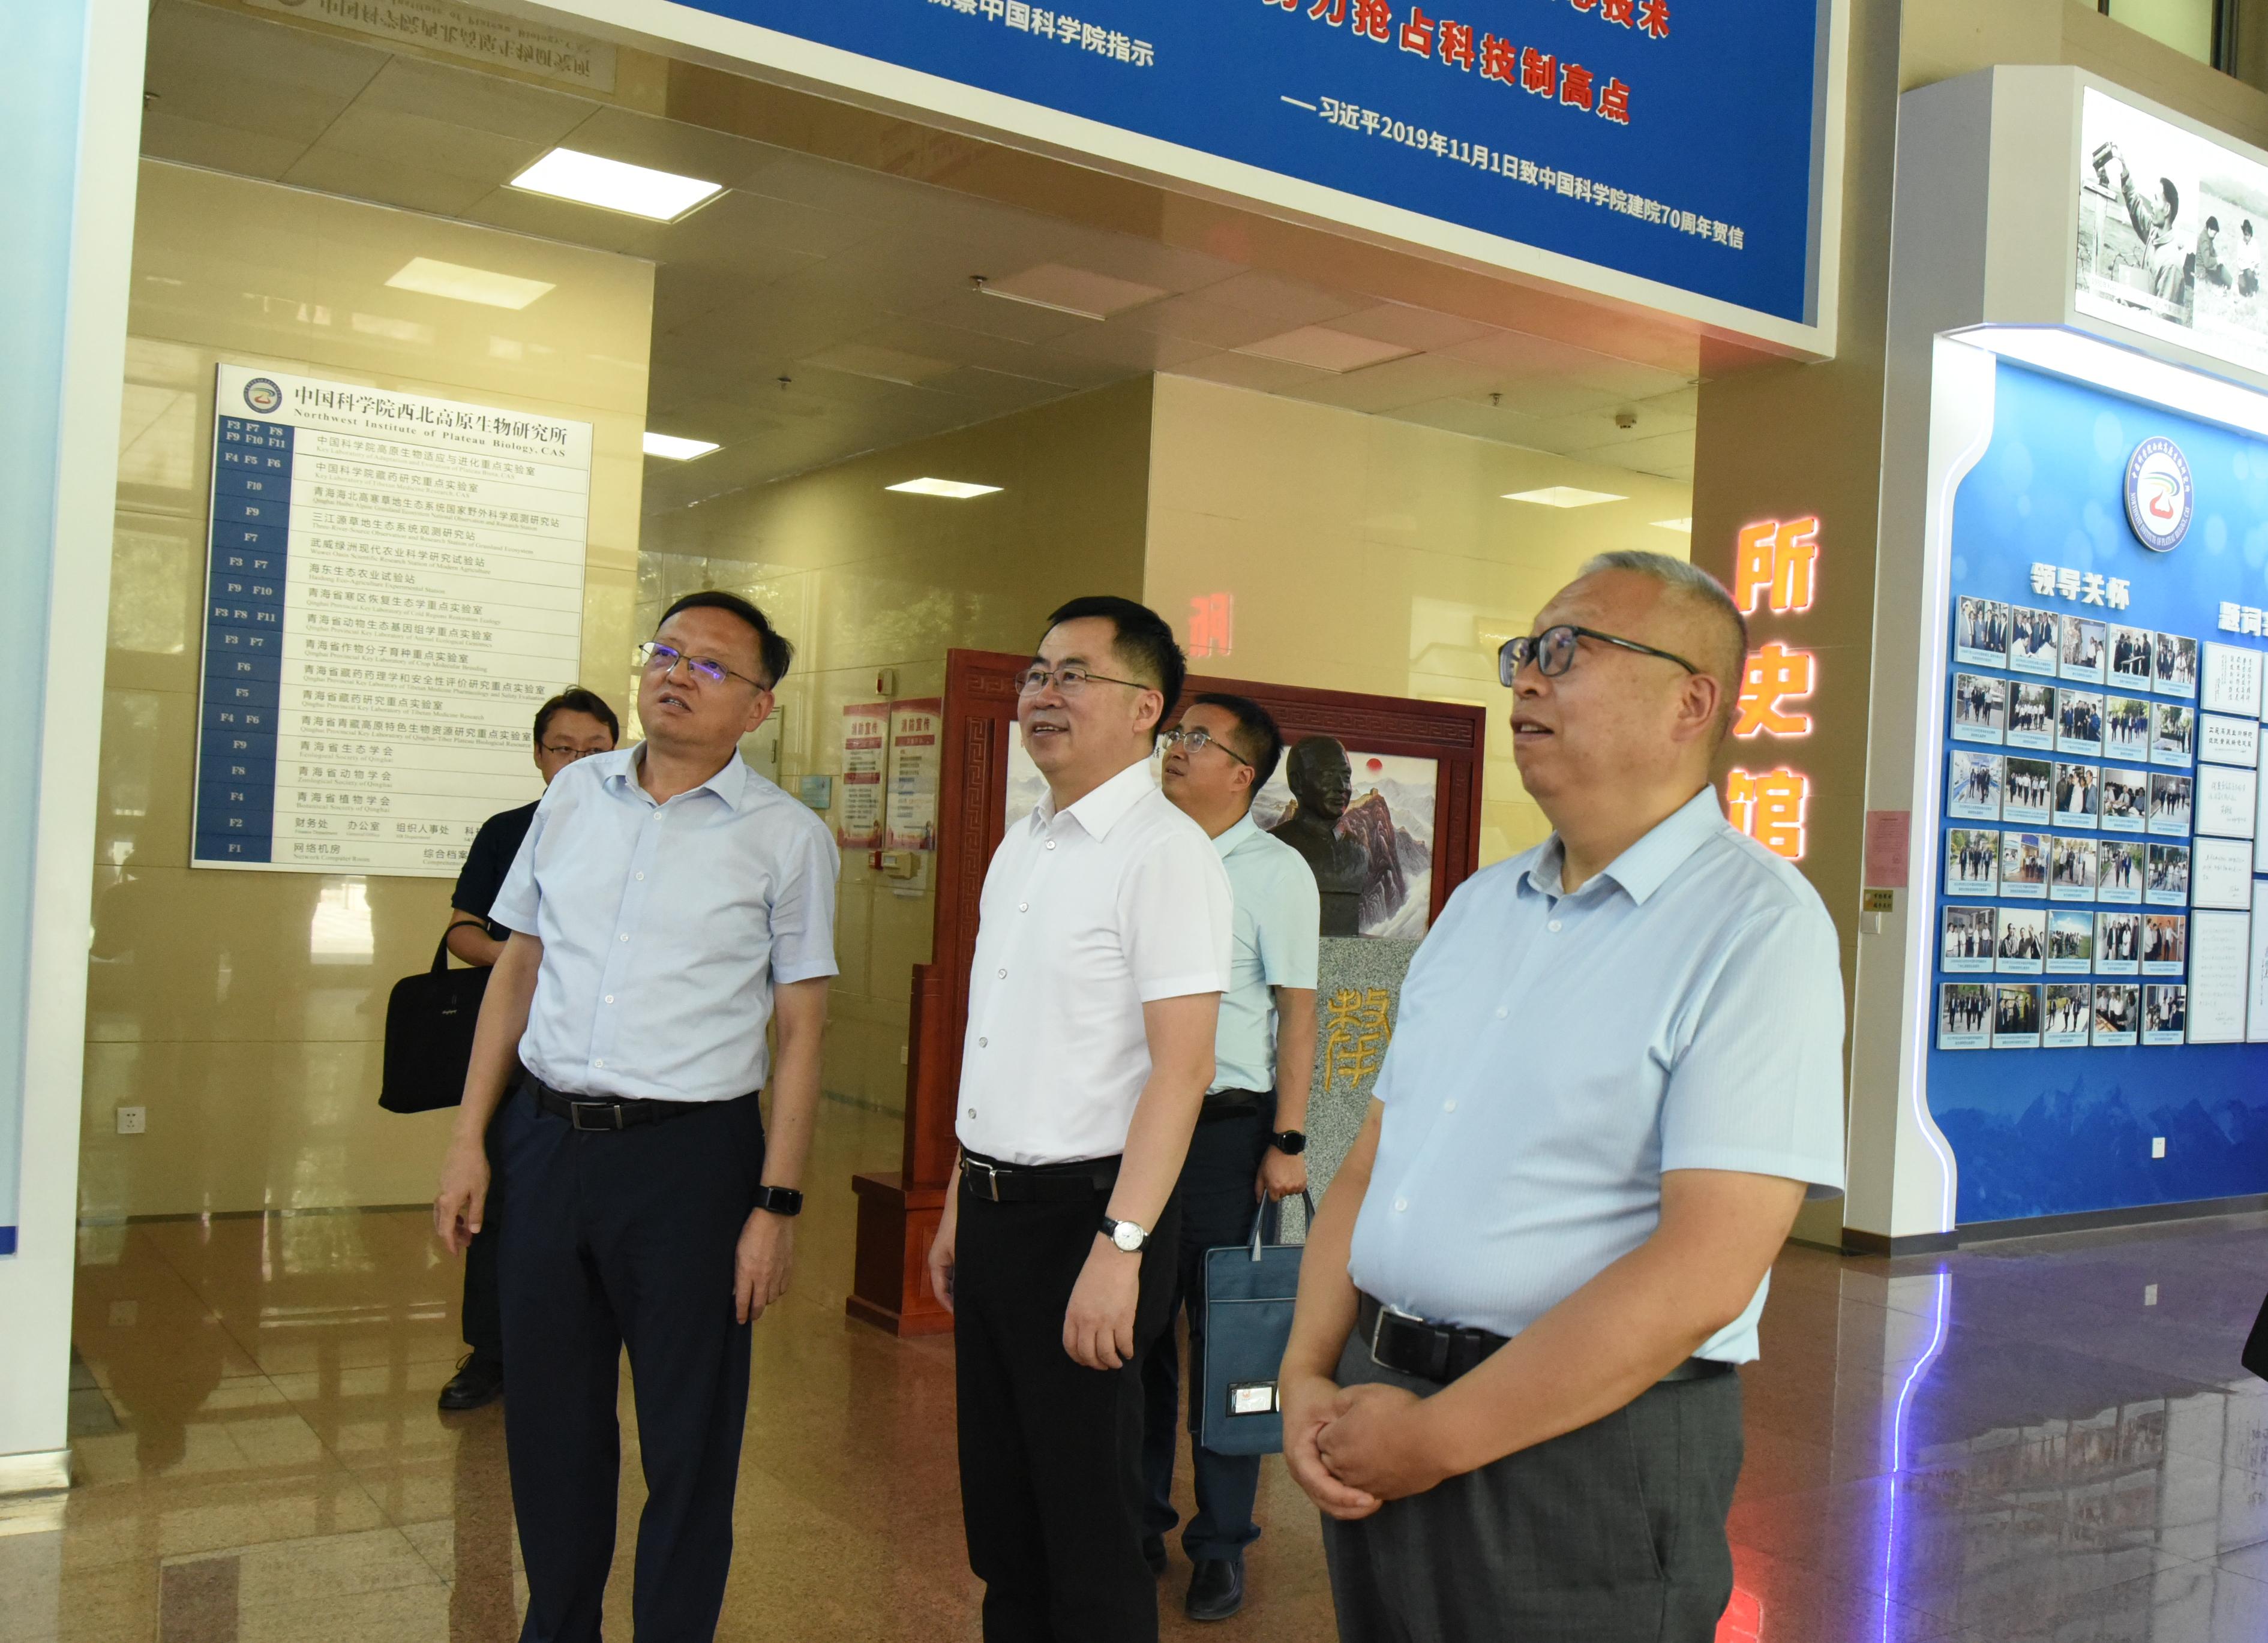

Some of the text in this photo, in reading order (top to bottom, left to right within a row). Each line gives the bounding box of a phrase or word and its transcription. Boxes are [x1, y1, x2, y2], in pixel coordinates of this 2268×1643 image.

[1264, 0, 1630, 124] 力抢占科技制高点
[295, 384, 566, 445] 中国科学院西北高原生物研究所
[227, 420, 283, 435] F3 F7 F8
[293, 408, 357, 426] Northwest
[365, 419, 416, 435] Institute
[443, 431, 485, 445] Plateau
[493, 438, 538, 455] Biology,
[541, 446, 565, 457] CAS
[226, 431, 285, 447] F9 F10 F11
[225, 452, 281, 468] F4 F5 F6
[317, 434, 535, 476] 中国科学院高原生物适应与进化重点实验室
[316, 461, 478, 493] 中国科学院藏药研究重点实验室
[247, 481, 262, 490] F10
[245, 507, 259, 516] F9
[314, 486, 559, 527] 青海海北高寒草地生态系统国家野外科学观测研究站
[312, 511, 475, 541] 三江源草地生态系统观测研究站
[244, 533, 257, 542] F7
[311, 537, 485, 567] 武威绿洲现代农业科学研究试验站
[229, 557, 268, 569] F3 F7
[309, 563, 415, 584] 海东生态农业试验站
[227, 583, 272, 595] F9 F10
[2030, 561, 2130, 610] 领导关怀
[308, 587, 482, 615] 青海省寒区恢复生态学重点实验室
[214, 608, 275, 621] F3 F8 F11
[307, 613, 493, 641] 青海省动物生态基因组学重点实验室
[225, 635, 263, 646] F3 F7
[305, 639, 469, 663] 青海省作物分子育种重点实验室
[237, 662, 250, 671] F6
[304, 664, 545, 694] 青海省藏药药理学和安全性评价研究重点实验室
[235, 688, 248, 697] F5
[1727, 518, 1816, 860] 所史馆
[302, 690, 443, 710] 青海省藏药研究重点实验室
[220, 713, 259, 724] F4 F6
[301, 715, 532, 741] 青海省青藏高原特色生物资源研究重点实验室
[232, 740, 247, 749] F9
[300, 740, 393, 756] 青海省生态学会
[231, 766, 245, 775] F8
[298, 766, 391, 781] 青海省动物学会
[230, 792, 244, 801] F4
[296, 791, 390, 806] 青海省植物学会
[229, 818, 242, 827] F2
[295, 817, 328, 828] 财务处
[347, 820, 380, 831] 办公室
[396, 822, 449, 834] 组织人事处
[228, 844, 241, 852] F1
[293, 842, 340, 854] 网络机房
